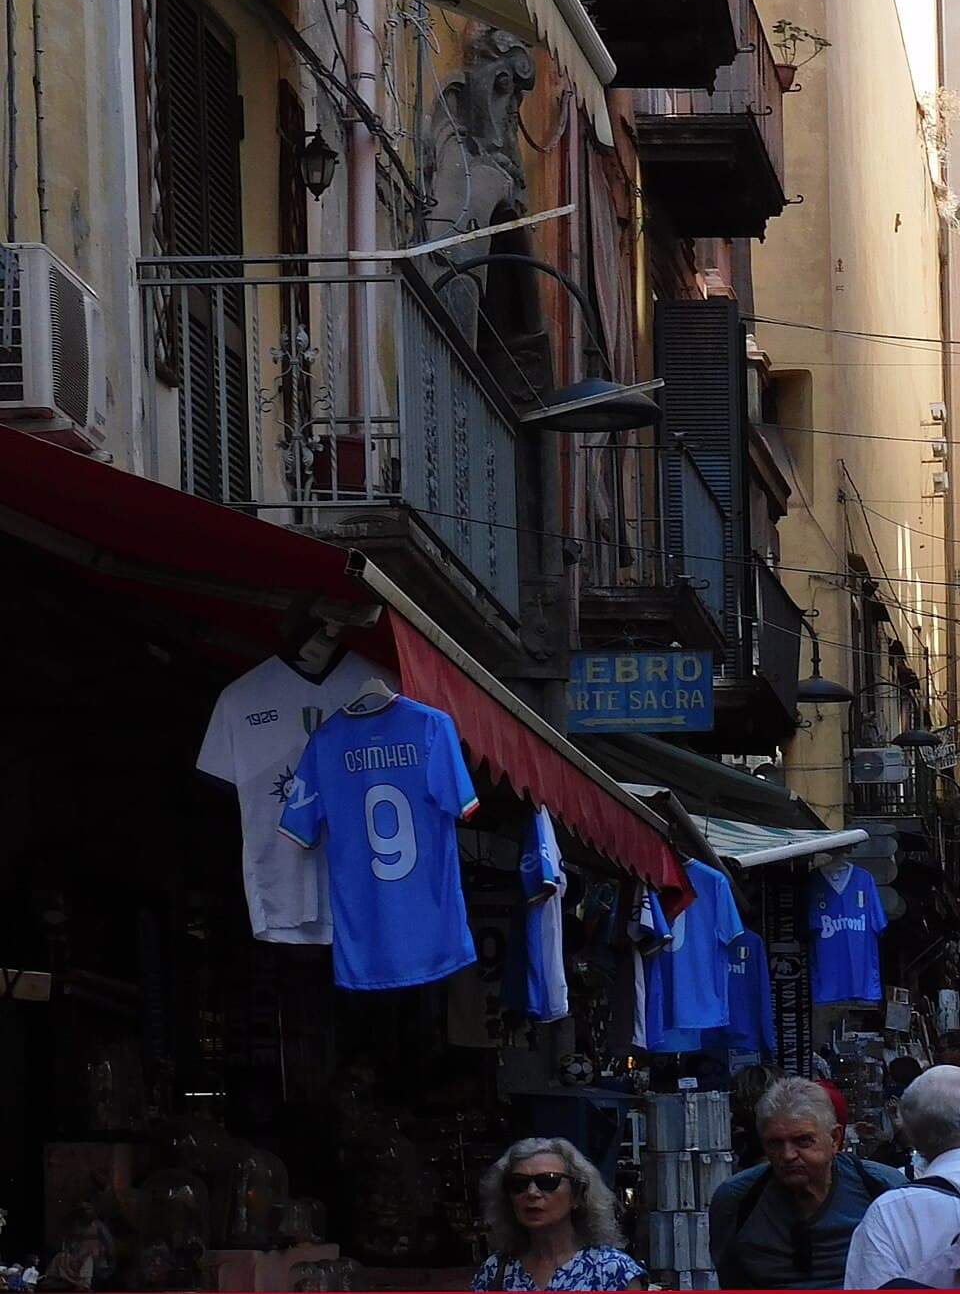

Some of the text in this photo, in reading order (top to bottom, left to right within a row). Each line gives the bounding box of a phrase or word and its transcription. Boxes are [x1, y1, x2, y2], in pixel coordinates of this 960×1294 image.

[568, 655, 703, 684] EBRO
[628, 688, 706, 710] SACRA
[244, 708, 280, 727] 1926
[344, 742, 420, 773] OSIMHEN
[364, 782, 419, 882] 9
